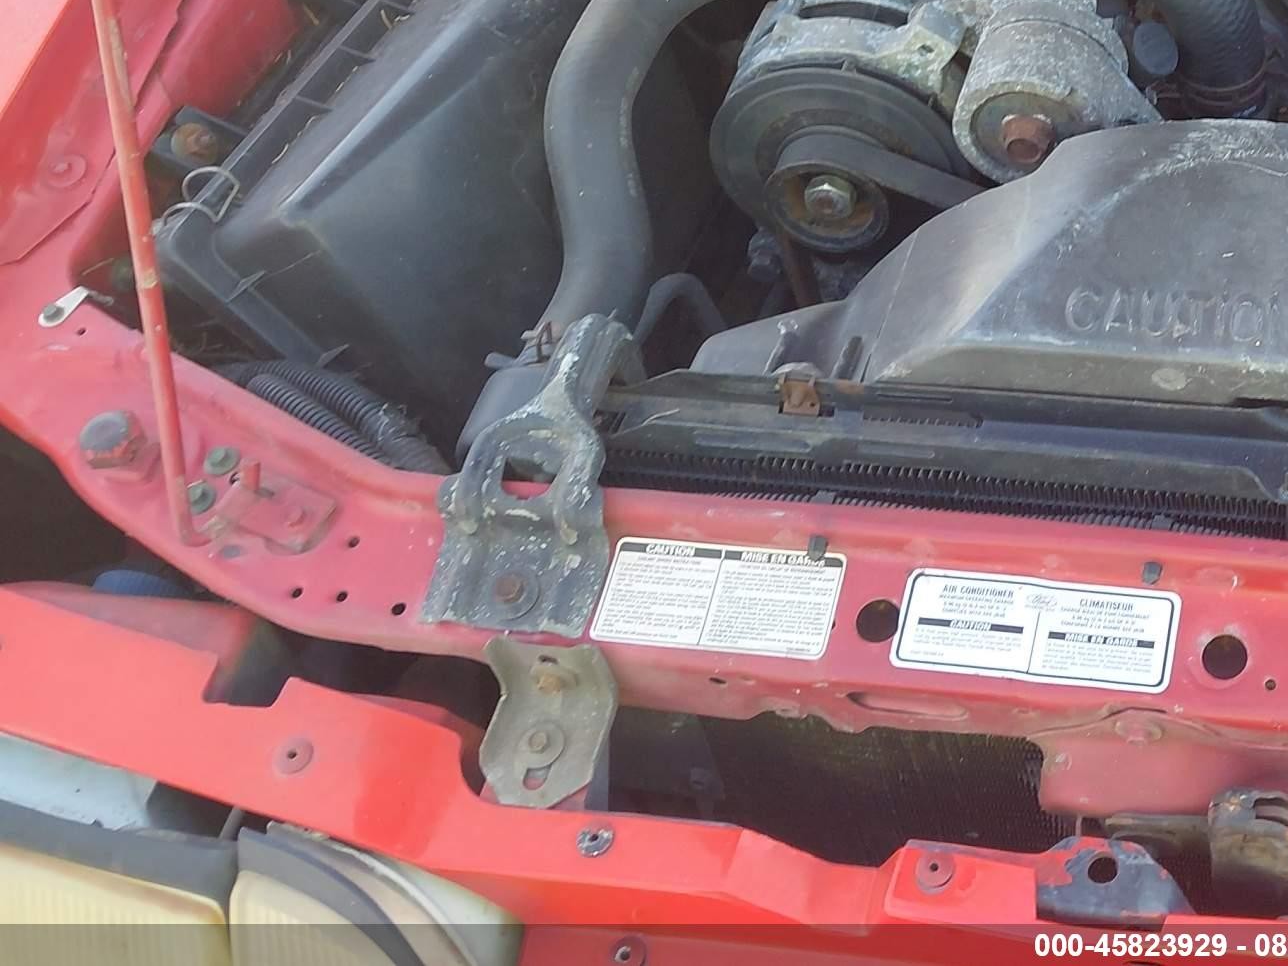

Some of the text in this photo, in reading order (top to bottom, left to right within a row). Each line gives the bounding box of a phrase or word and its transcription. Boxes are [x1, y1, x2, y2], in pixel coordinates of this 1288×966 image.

[646, 543, 696, 557] CAUTION
[771, 553, 788, 565] EN
[943, 584, 1015, 598] AIR CONDITIONER
[1080, 598, 1134, 611] CLIMATISEUR
[950, 619, 992, 632] CAUTION
